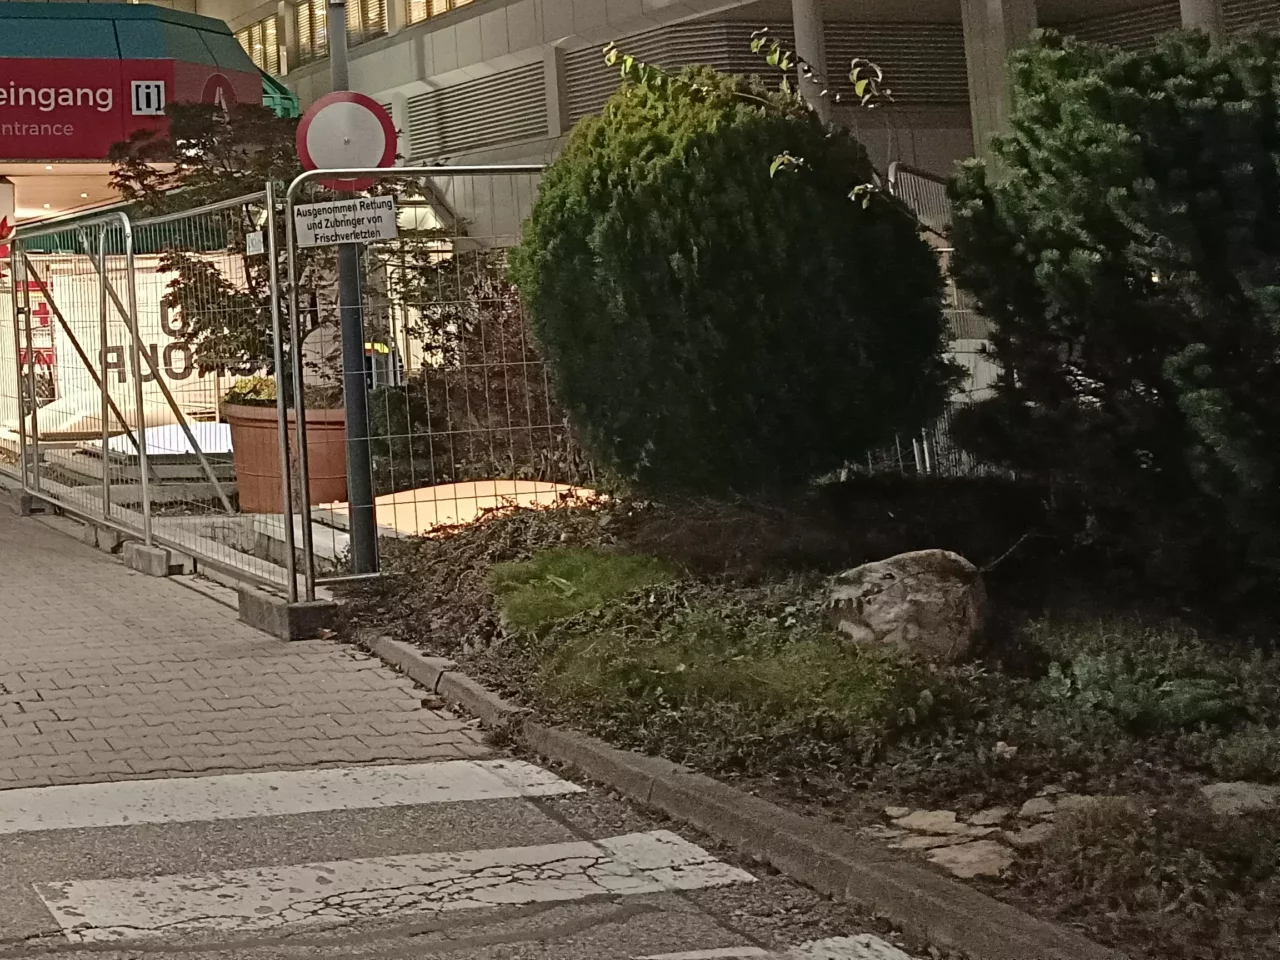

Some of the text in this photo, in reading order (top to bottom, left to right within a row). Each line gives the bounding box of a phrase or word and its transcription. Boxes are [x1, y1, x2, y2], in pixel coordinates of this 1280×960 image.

[296, 199, 393, 219] Ausgenommen Rettung
[307, 215, 383, 231] und Zubringer von
[314, 229, 381, 243] Frischverletzten
